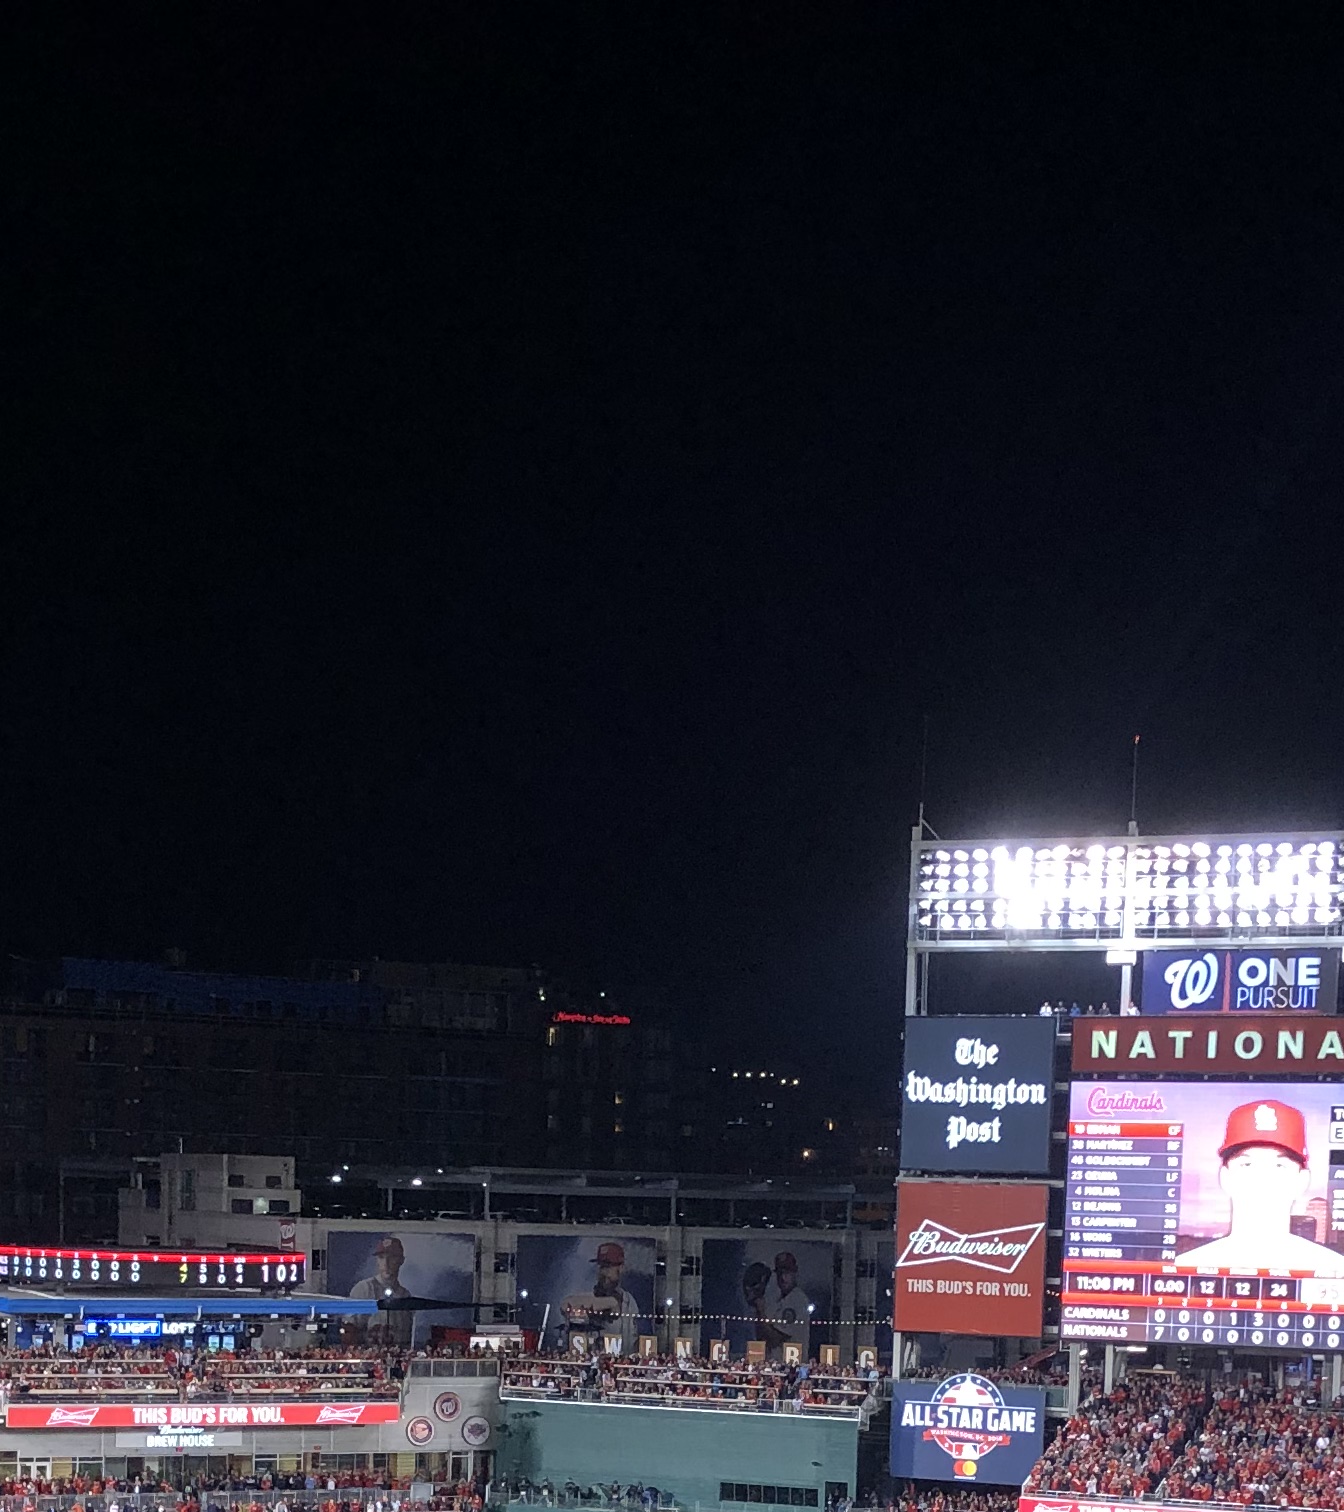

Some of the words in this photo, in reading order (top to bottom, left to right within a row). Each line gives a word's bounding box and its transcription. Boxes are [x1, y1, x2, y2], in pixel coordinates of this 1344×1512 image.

[1238, 957, 1322, 986] ONE
[1236, 986, 1320, 1008] PURSUIT
[955, 1037, 999, 1068] The
[906, 1071, 1047, 1110] Washington
[1087, 1087, 1167, 1116] Cardinals
[945, 1116, 1001, 1149] Post
[909, 1230, 1028, 1257] Budweiser
[907, 1279, 934, 1293] THIS
[937, 1280, 973, 1294] BUD'S
[976, 1282, 1000, 1295] FOR
[1003, 1283, 1031, 1297] YOU.
[1113, 1277, 1135, 1291] PM
[1155, 1280, 1185, 1292] 0.00
[1200, 1281, 1215, 1293] 12
[1235, 1282, 1250, 1295] 12
[1271, 1284, 1288, 1296] 24
[1065, 1306, 1129, 1320] CARDINALS
[162, 1322, 195, 1334] LOFT
[1063, 1324, 1128, 1338] NATIONALS
[1252, 1331, 1263, 1344] 0
[1277, 1332, 1288, 1345] 0
[1302, 1333, 1313, 1345] 0
[1327, 1334, 1339, 1347] 0
[133, 1407, 167, 1424] THIS
[170, 1407, 216, 1424] BUD'S
[219, 1407, 247, 1423] FOR
[252, 1407, 285, 1423] YOU.
[901, 1404, 934, 1426] ALL
[936, 1406, 983, 1430] STAR
[987, 1409, 1036, 1432] GAME
[146, 1435, 177, 1447] BREW
[180, 1434, 215, 1447] HOUSE
